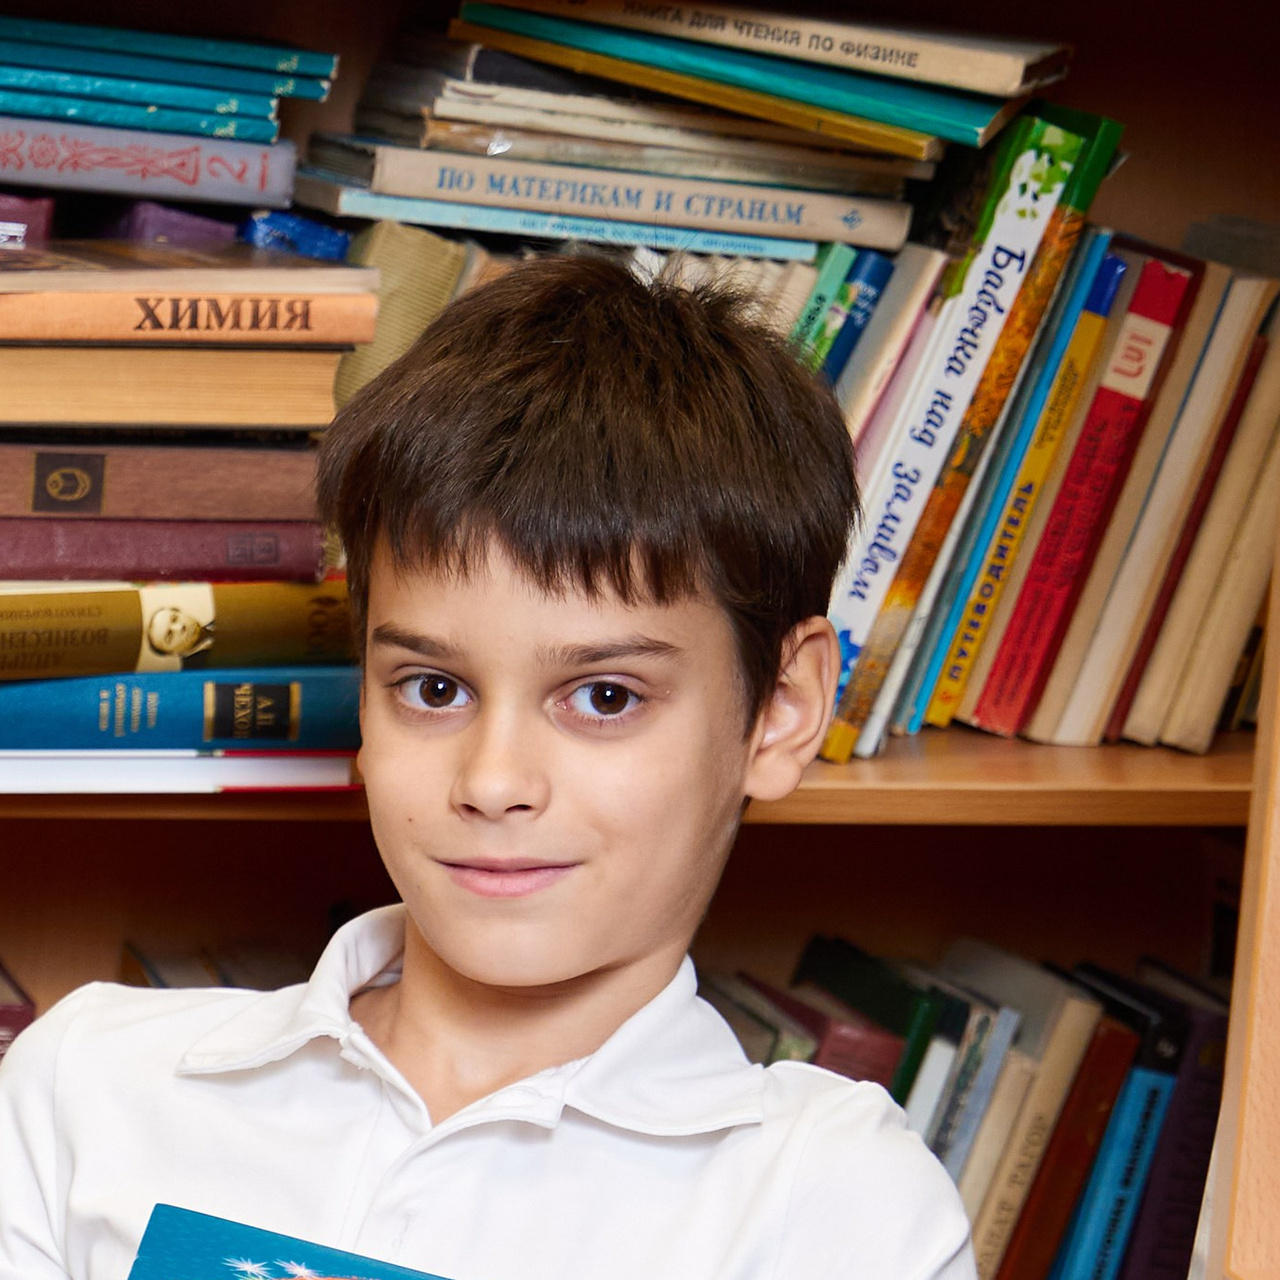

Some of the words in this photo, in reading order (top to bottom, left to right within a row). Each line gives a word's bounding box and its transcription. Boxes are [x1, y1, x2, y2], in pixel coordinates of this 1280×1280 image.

[689, 12, 726, 30] ДЛЯ
[733, 21, 800, 46] ЧТЕНИЯ
[808, 35, 832, 52] ПО
[437, 166, 474, 192] ПО
[485, 171, 641, 211] МАТЕРИКАМ
[653, 192, 672, 212] И
[685, 193, 804, 225] СТРАНАМ
[133, 298, 312, 331] ХИМИЯ
[944, 242, 1027, 379] Бабочка
[910, 389, 954, 448] над
[847, 461, 923, 601] заливом
[948, 482, 1036, 680] ПУТЕВОДИТЕЛЬ
